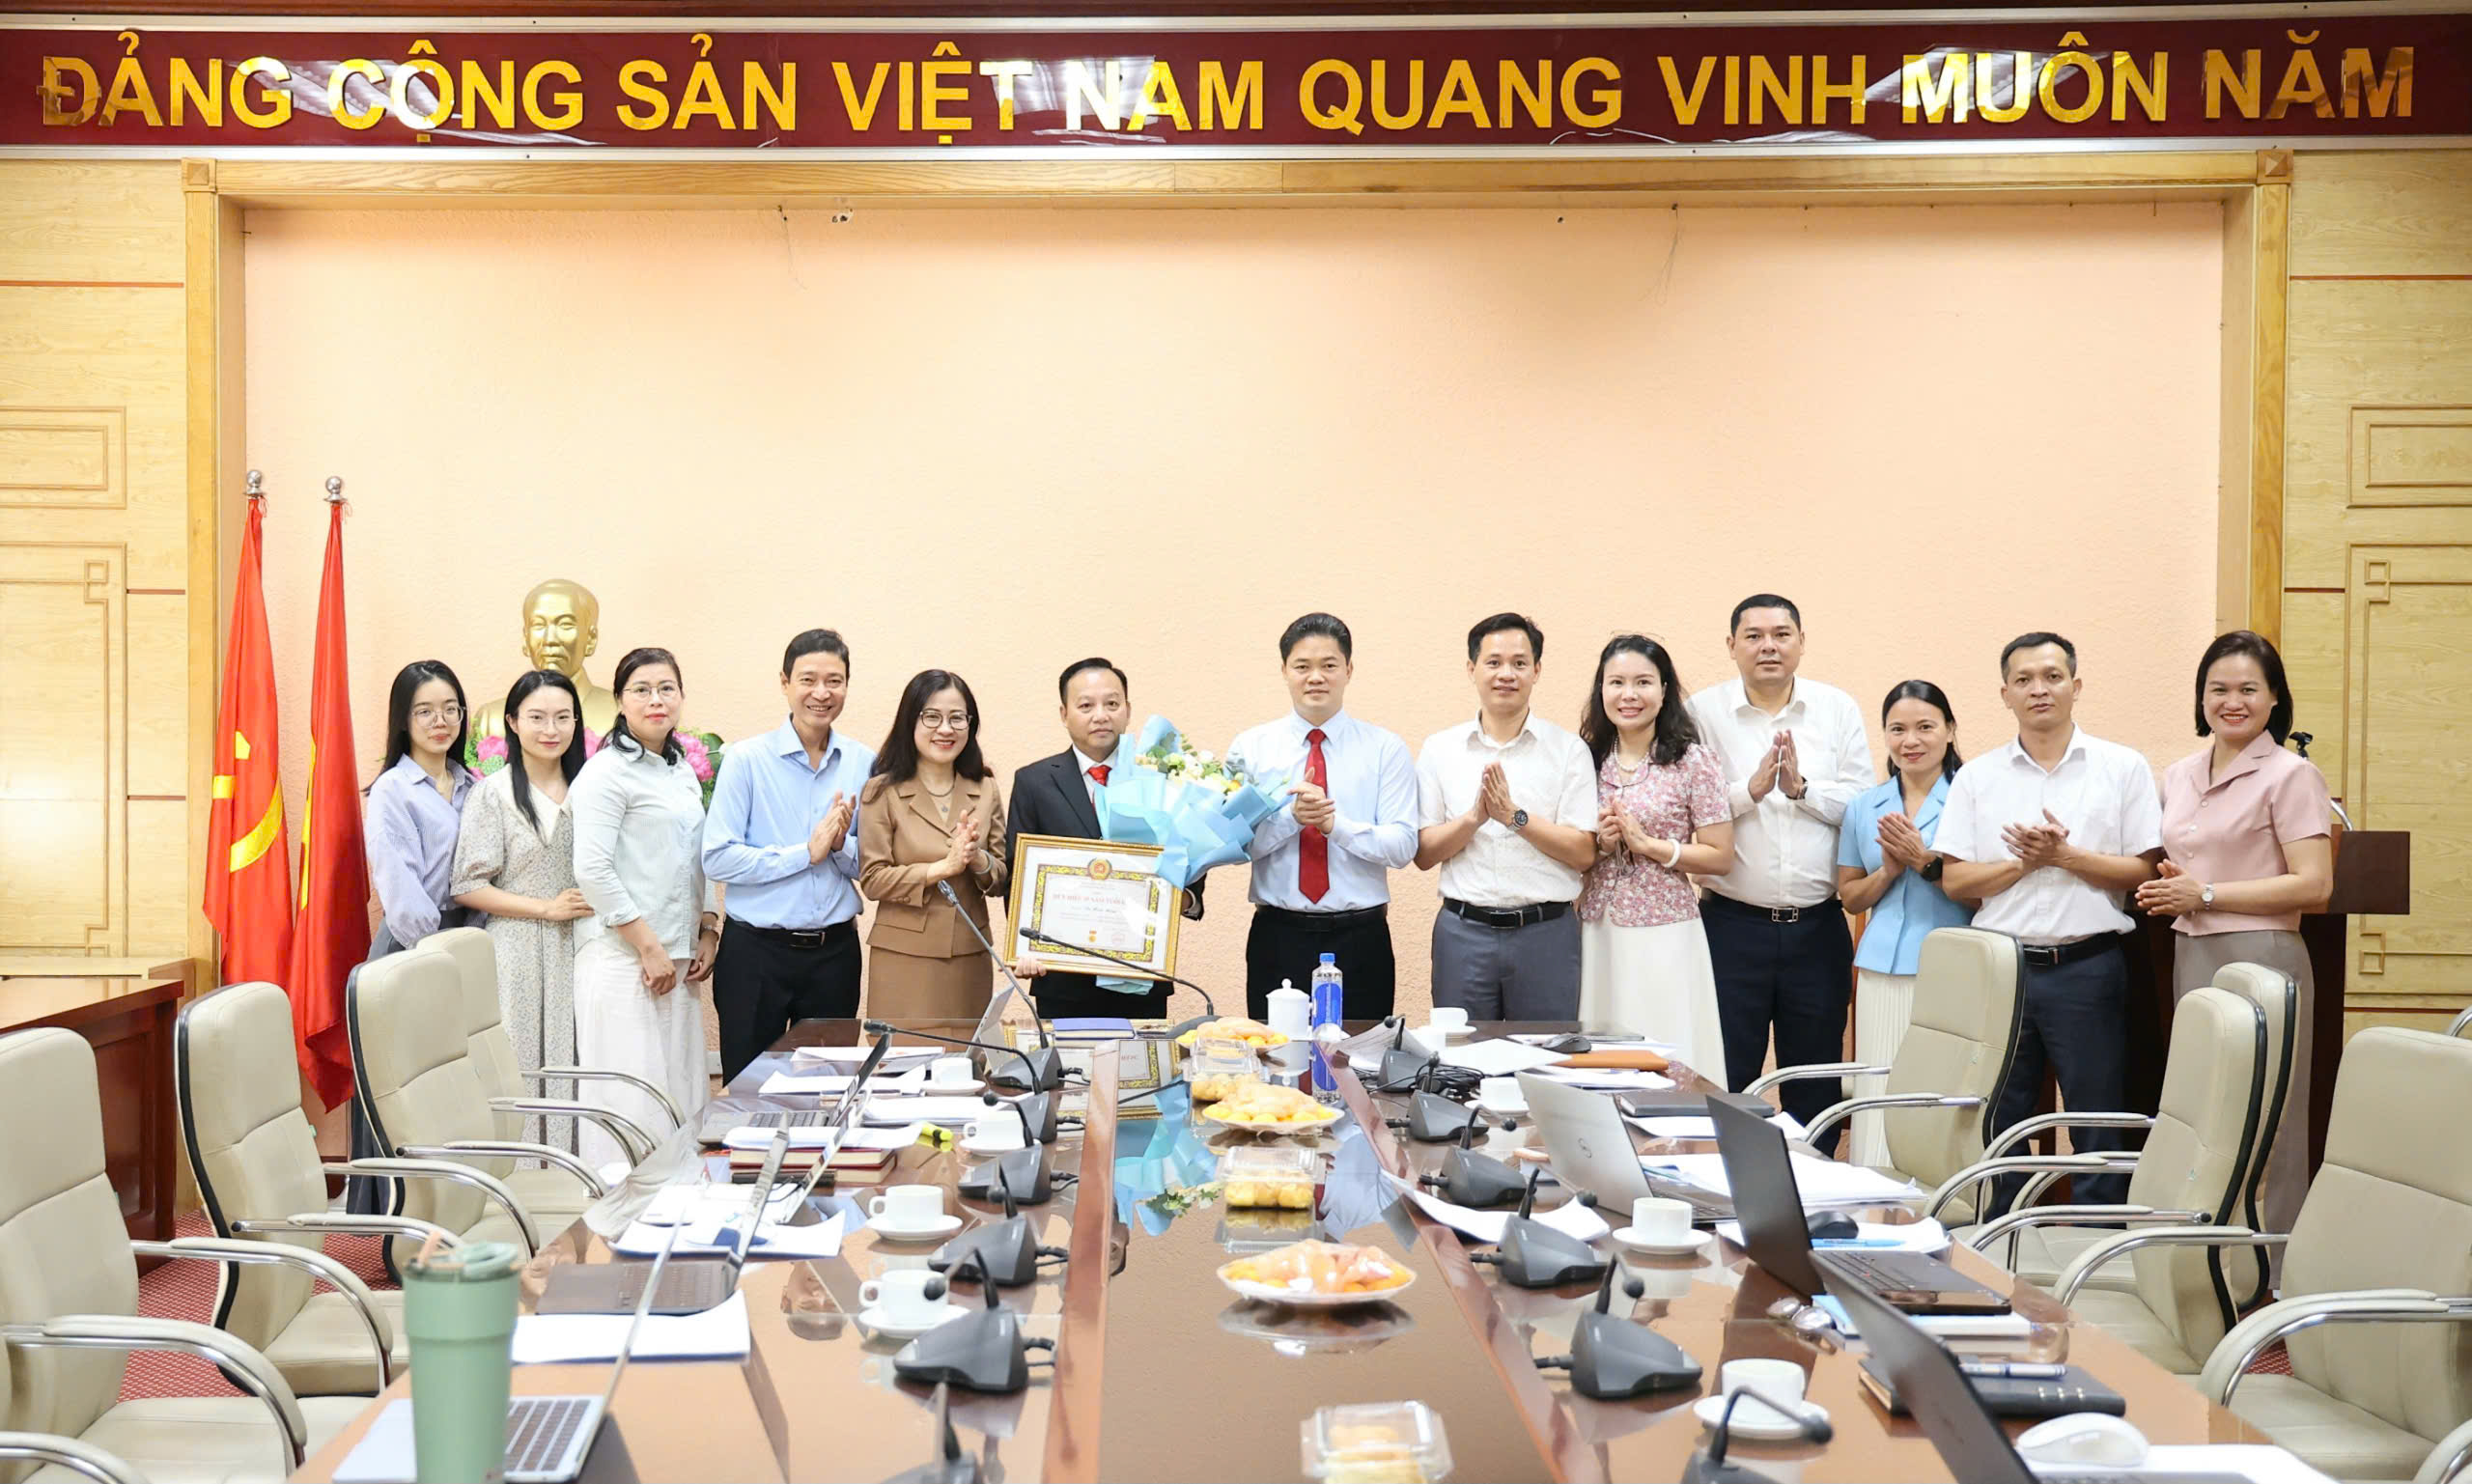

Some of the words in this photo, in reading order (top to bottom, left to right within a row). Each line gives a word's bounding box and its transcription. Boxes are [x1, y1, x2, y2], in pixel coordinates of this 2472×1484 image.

[37, 31, 292, 128] ĐẢNG
[328, 40, 584, 142] CỘNG
[617, 33, 797, 130] SẢN
[832, 42, 1033, 144] VIỆT
[1066, 58, 1263, 130] NAM
[1300, 59, 1622, 135] QUANG
[1658, 55, 1866, 126] VINH
[1901, 32, 2168, 125] MUÔN
[2203, 29, 2414, 120] NĂM
